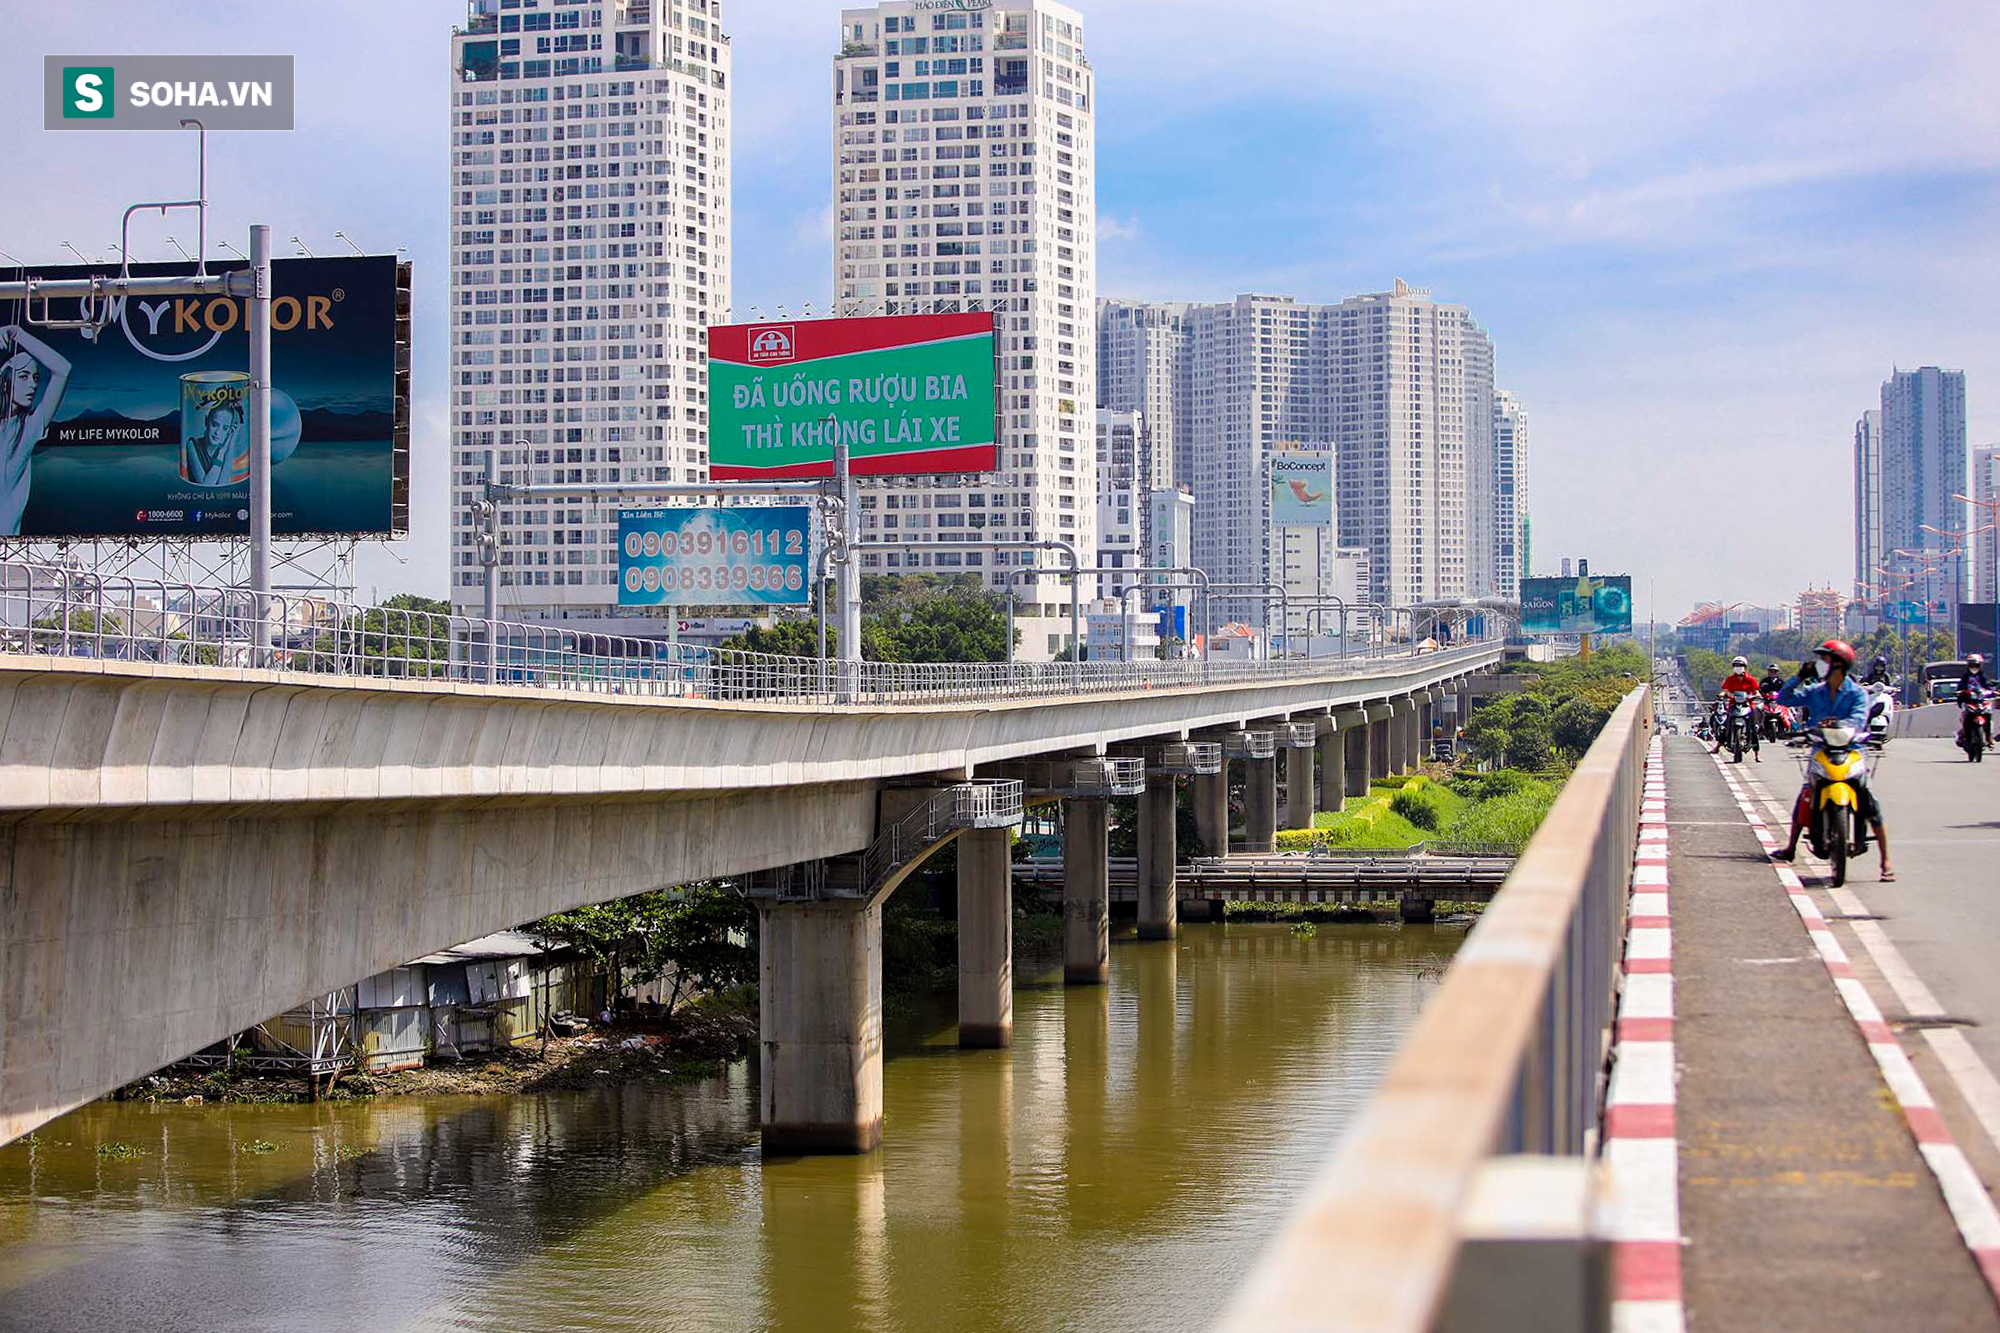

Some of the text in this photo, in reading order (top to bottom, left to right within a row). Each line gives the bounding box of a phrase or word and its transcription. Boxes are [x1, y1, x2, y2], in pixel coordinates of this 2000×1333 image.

[733, 373, 968, 409] ĐÃ UỐNG RƯỢU BIA
[60, 428, 160, 440] MY LIFE MYKOLOR
[742, 410, 961, 448] THÌ KHÔNG LÁI XE
[1276, 461, 1326, 472] BoConcept
[148, 510, 184, 519] 1800-6600
[205, 511, 231, 520] Mykolor
[621, 510, 634, 519] Xin
[625, 530, 802, 557] 0903916112
[625, 564, 802, 592] 0908339366
[1522, 600, 1554, 609] SAIGON
